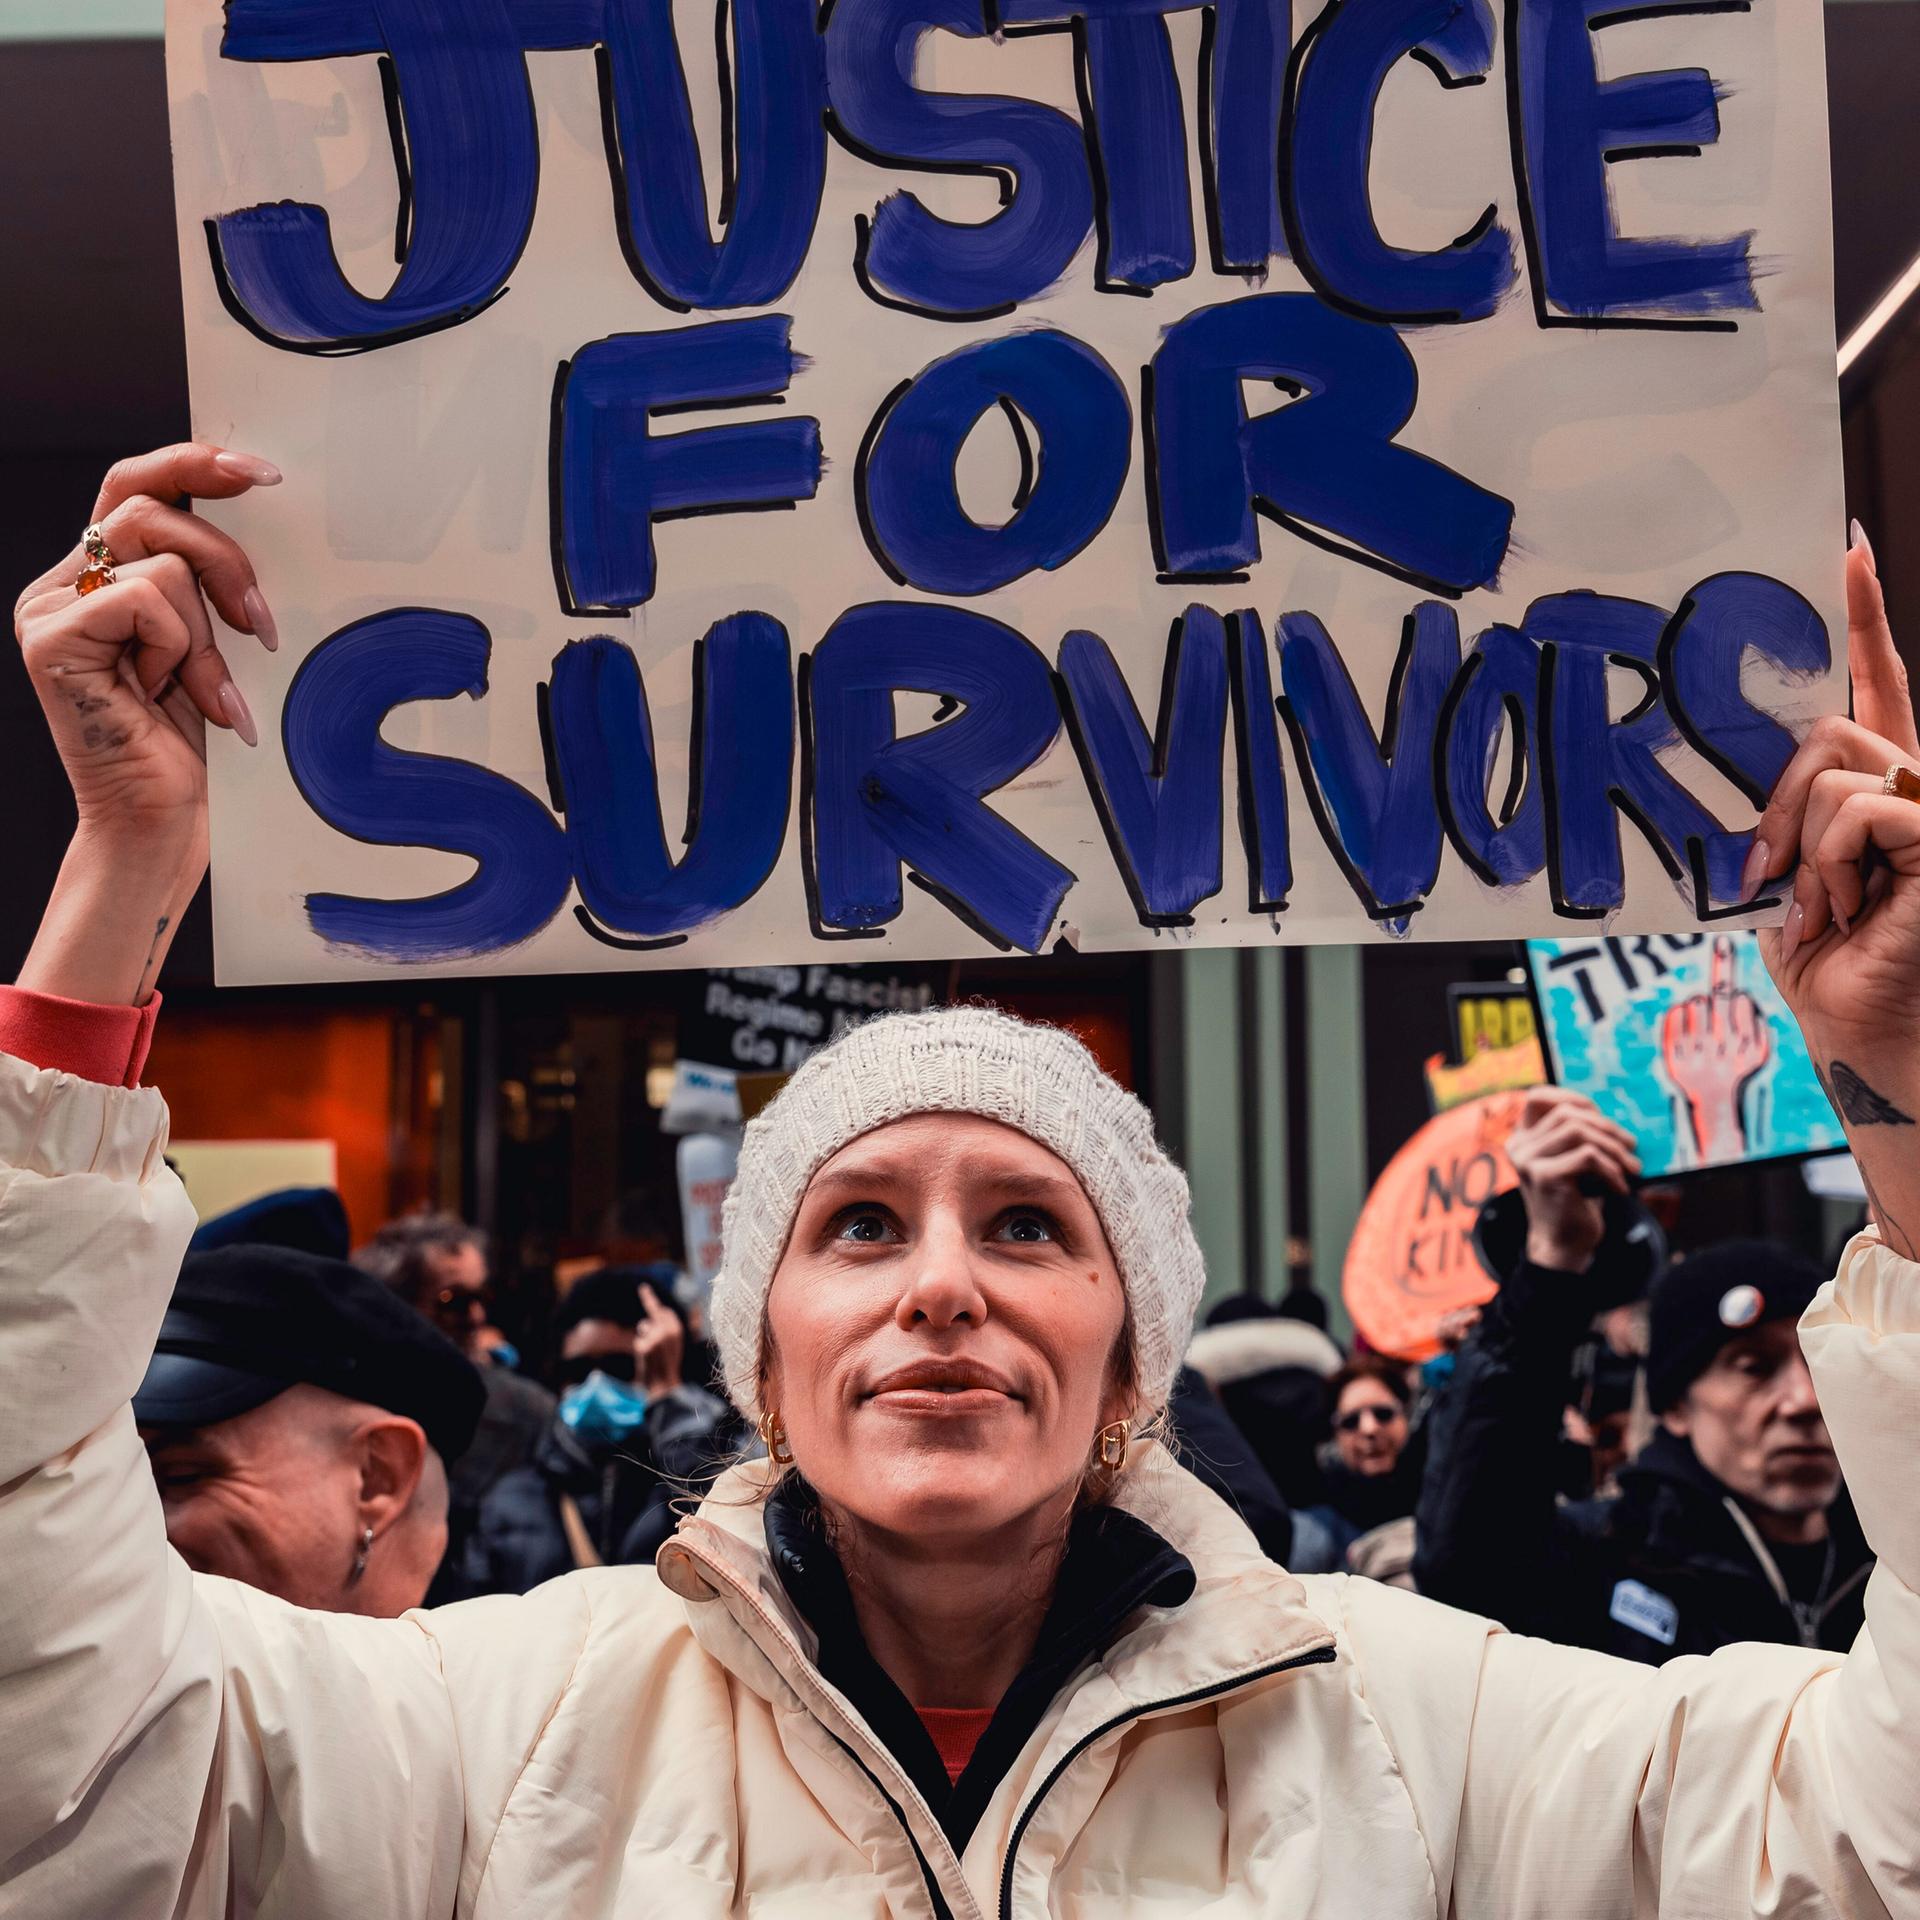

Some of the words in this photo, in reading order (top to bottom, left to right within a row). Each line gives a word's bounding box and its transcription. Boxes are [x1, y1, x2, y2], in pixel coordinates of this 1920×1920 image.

[204, 0, 1766, 356] JUSTICE
[549, 292, 1517, 616] FOR
[281, 570, 1832, 964] SURVIVORS
[705, 980, 824, 1038] Regime
[805, 964, 933, 1012] Fascist
[731, 1026, 777, 1071] Go
[1420, 1152, 1497, 1219] NO
